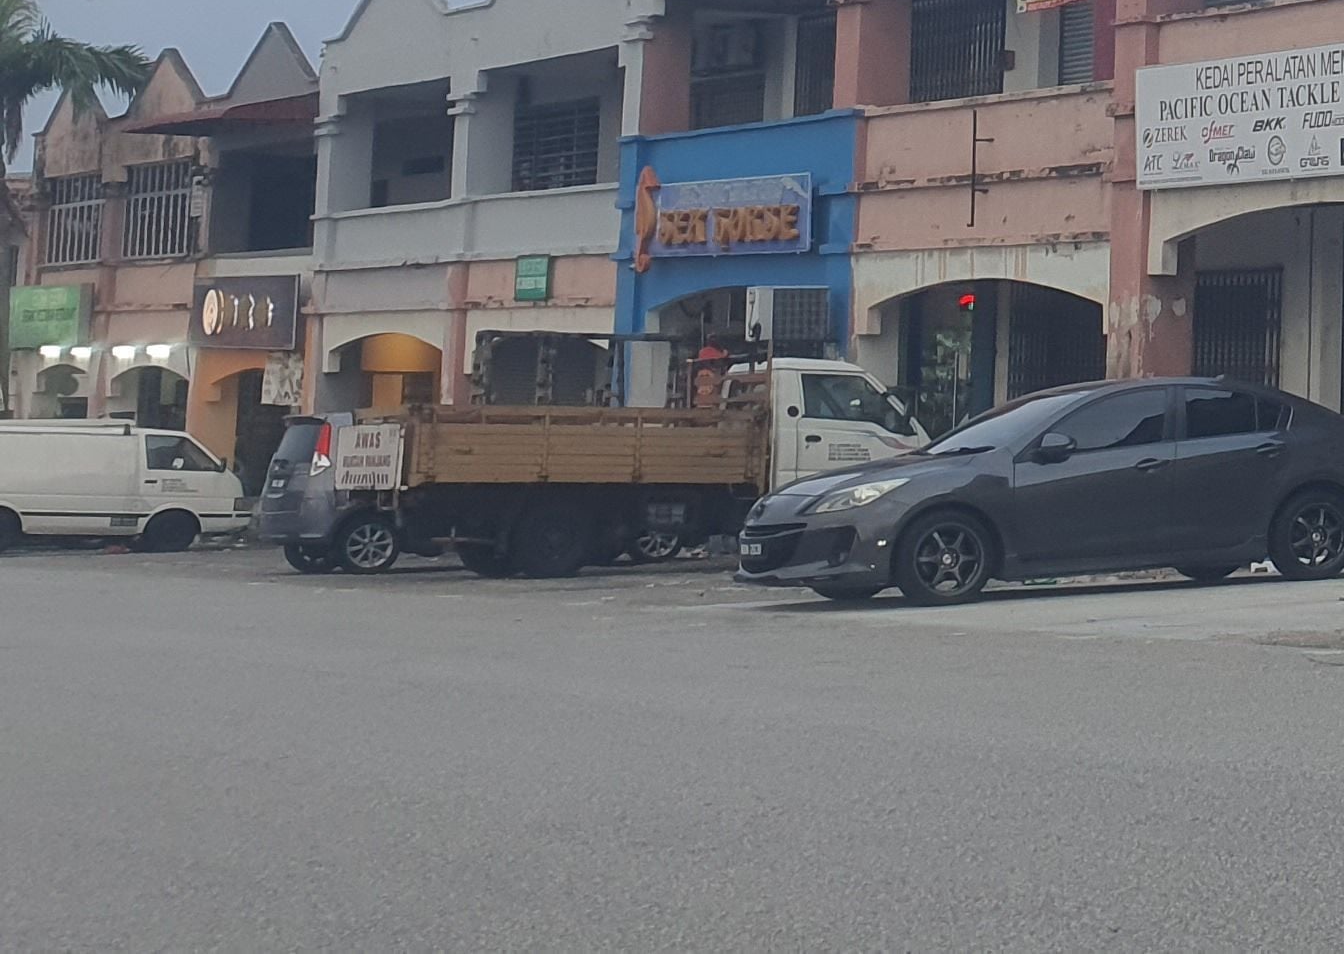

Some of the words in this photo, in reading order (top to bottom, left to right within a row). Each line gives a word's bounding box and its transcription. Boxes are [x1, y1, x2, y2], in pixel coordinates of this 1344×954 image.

[1195, 63, 1234, 91] KEDAI
[1237, 53, 1316, 86] PERALATAN
[1159, 95, 1213, 122] PACIFIC
[1218, 88, 1272, 116] OCEAN
[1277, 80, 1341, 109] TACKLE
[1252, 116, 1287, 133] BKK
[1154, 125, 1188, 144] ZEREK
[1143, 154, 1163, 172] ATC
